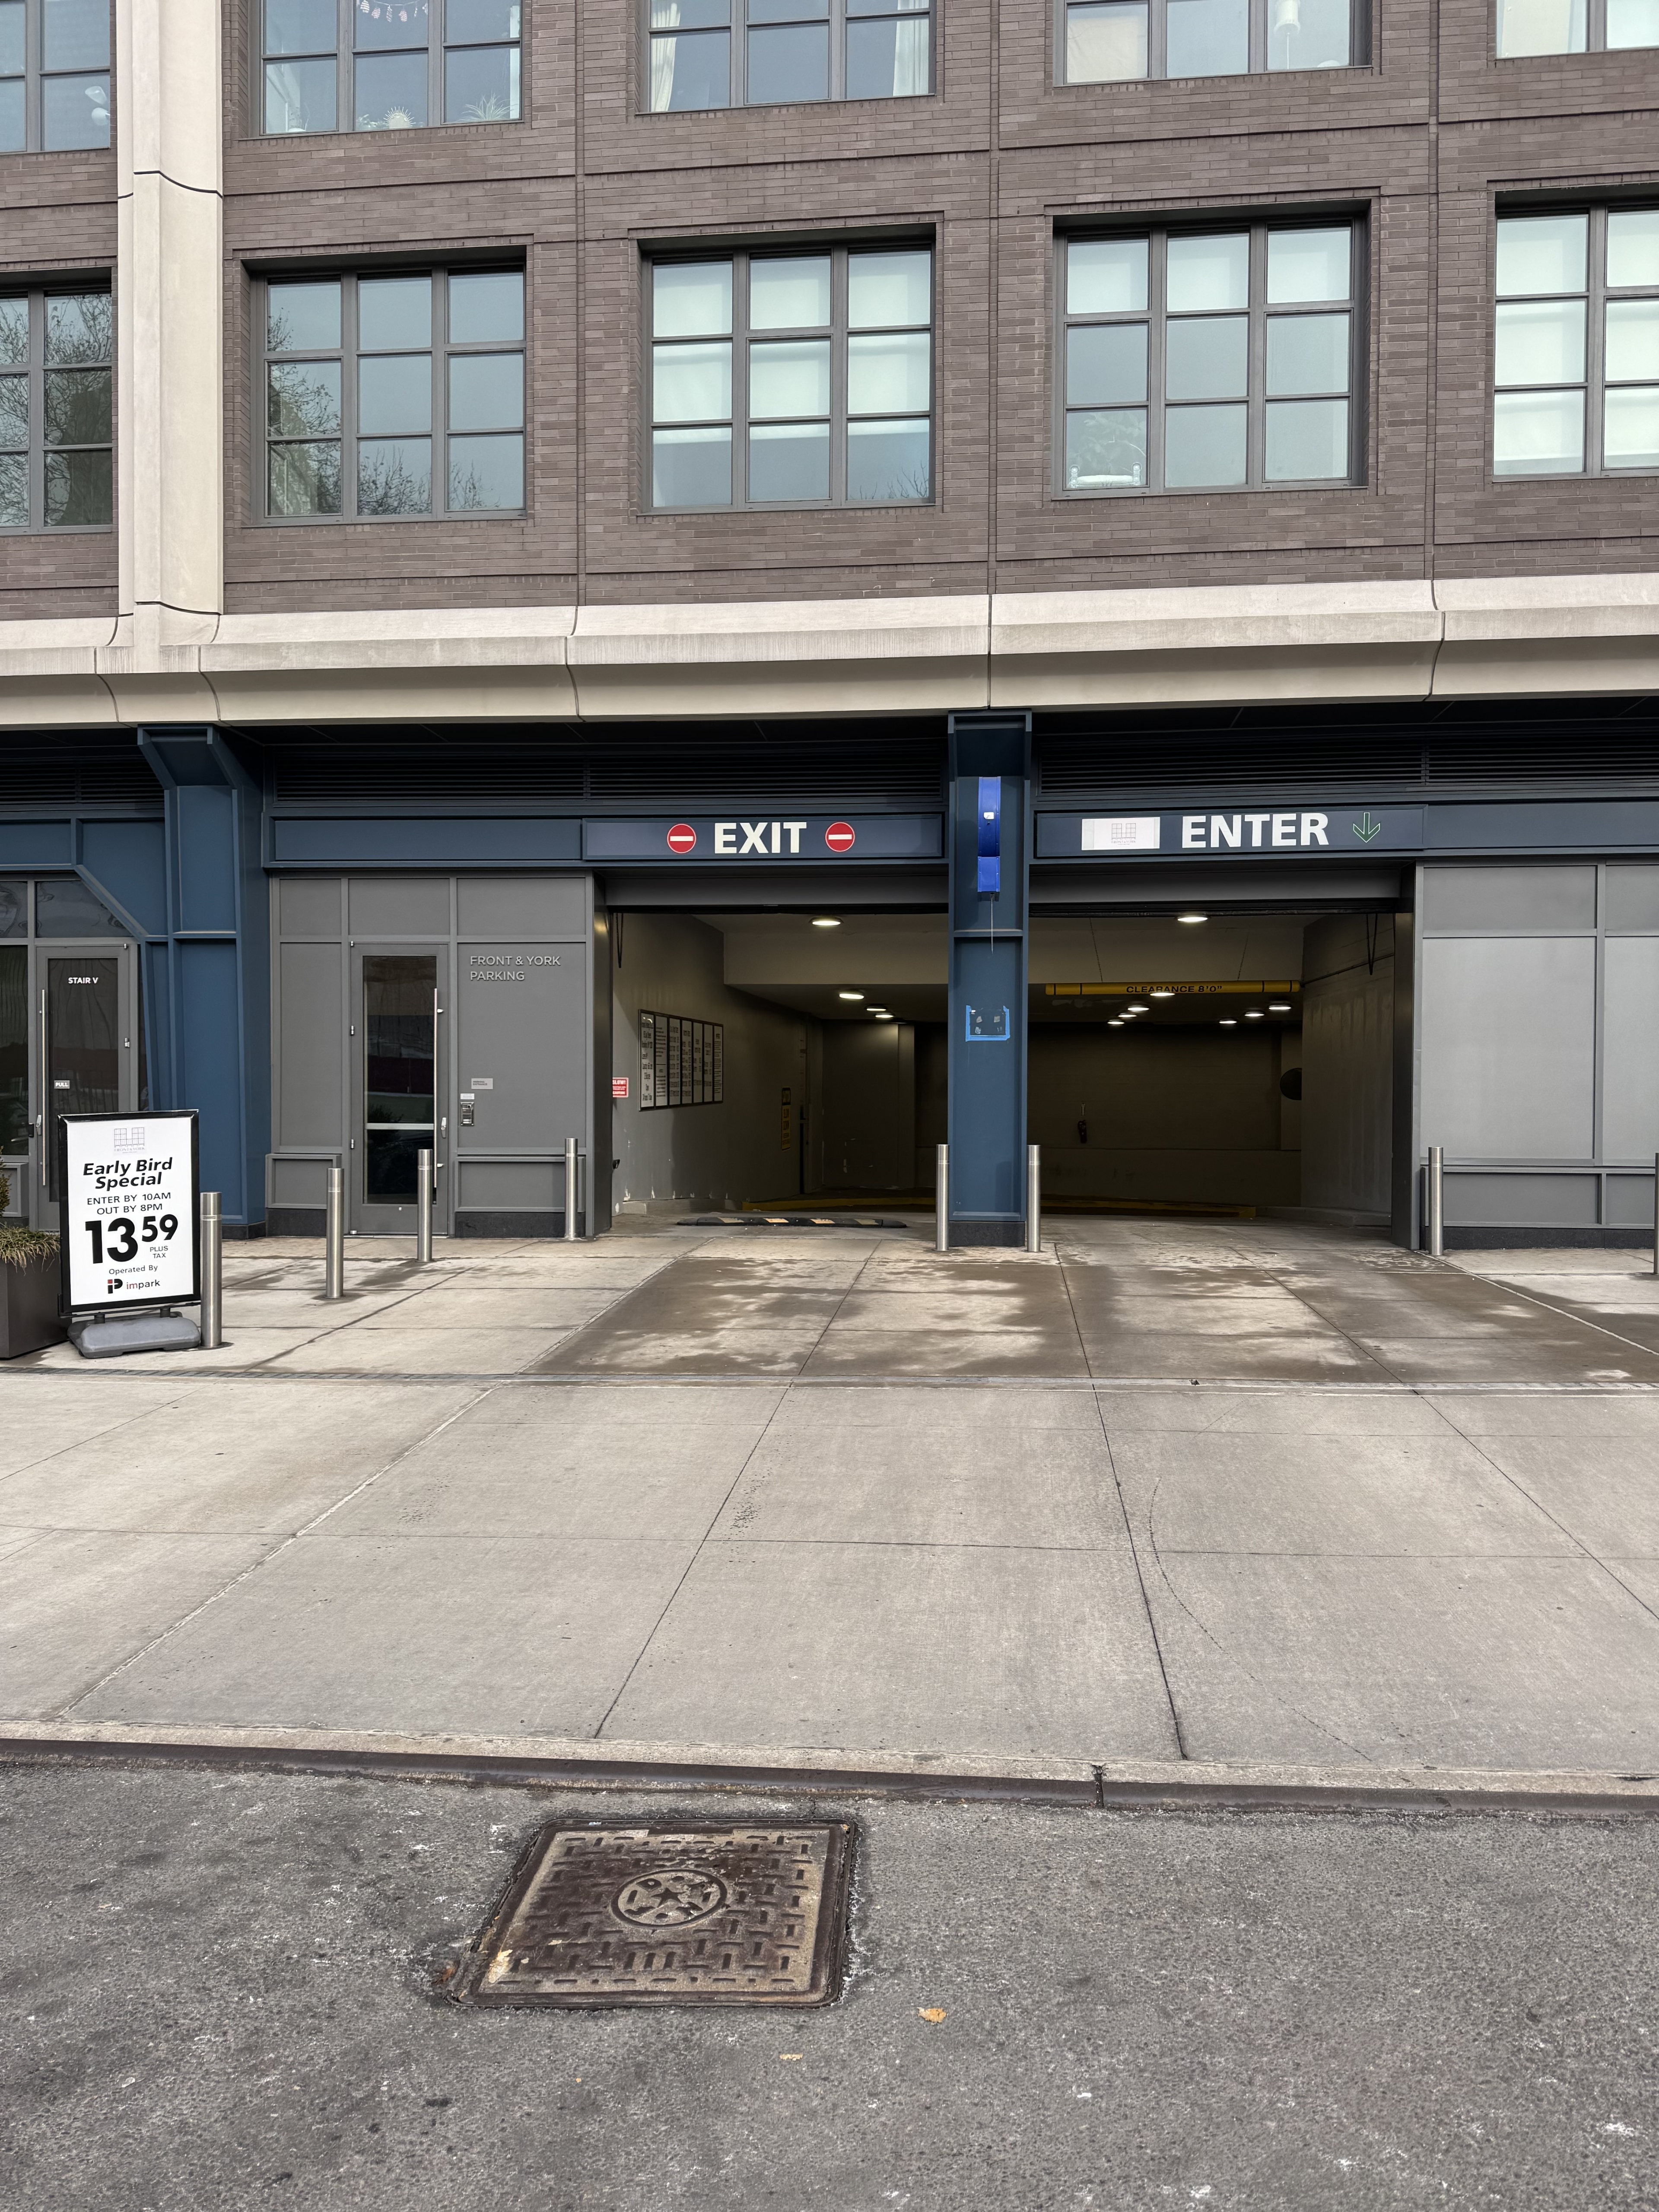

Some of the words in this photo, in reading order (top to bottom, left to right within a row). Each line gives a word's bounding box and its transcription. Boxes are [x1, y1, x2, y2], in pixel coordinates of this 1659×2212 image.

[715, 822, 807, 854] EXIT
[1182, 813, 1329, 848] ENTER
[470, 956, 512, 965] FRONT
[515, 956, 524, 965] &
[526, 956, 561, 966] YORK
[470, 971, 524, 981] PARKING
[83, 1160, 131, 1176] Early
[136, 1157, 172, 1172] Bird
[95, 1172, 162, 1191] Special
[87, 1196, 120, 1205] ENTER
[142, 1192, 171, 1201] 10AM
[85, 1217, 138, 1264] 13
[142, 1214, 178, 1242] 59
[109, 1265, 145, 1275] Operated
[127, 1280, 160, 1290] impark
